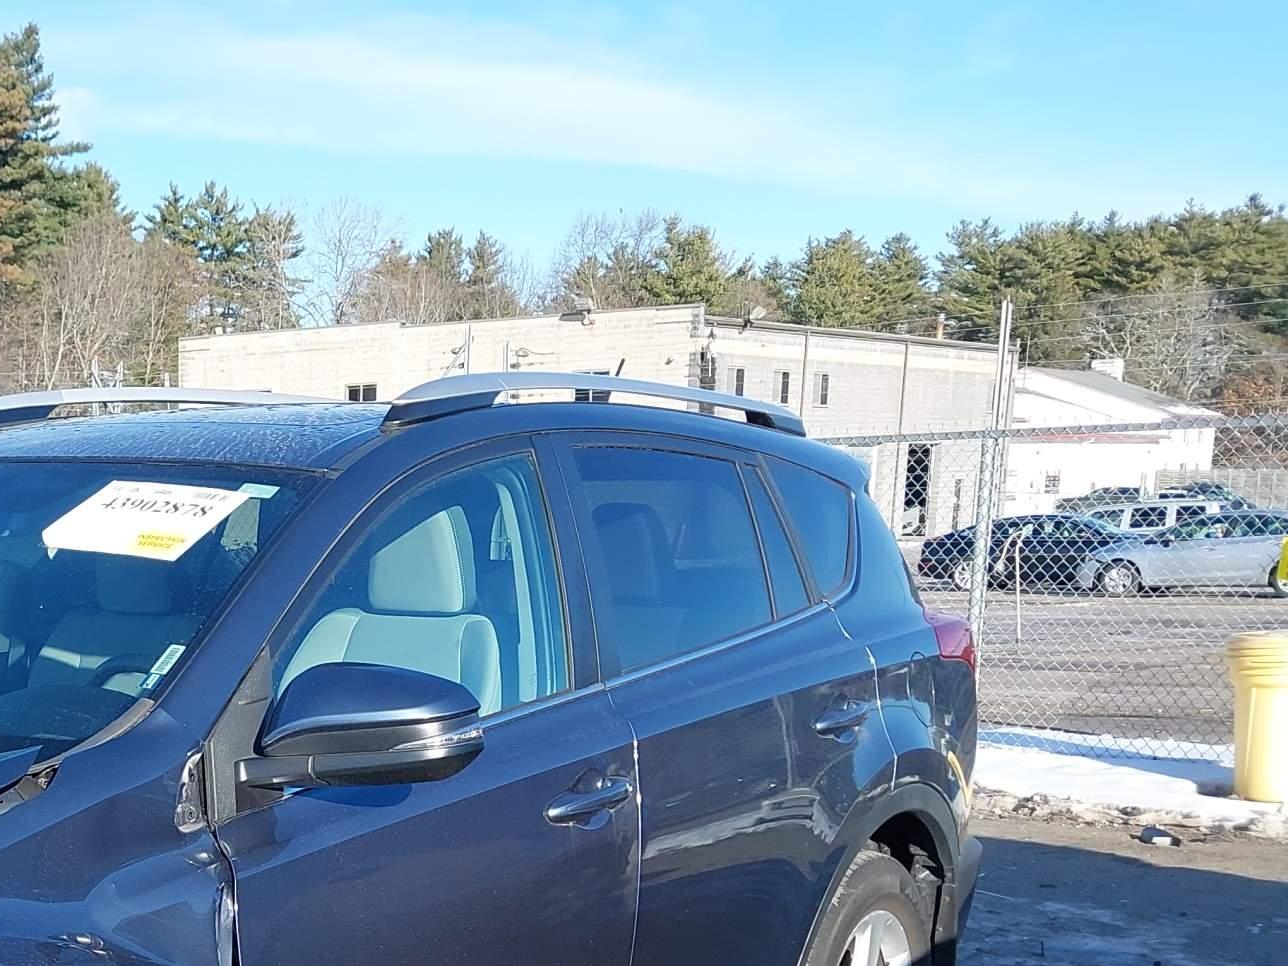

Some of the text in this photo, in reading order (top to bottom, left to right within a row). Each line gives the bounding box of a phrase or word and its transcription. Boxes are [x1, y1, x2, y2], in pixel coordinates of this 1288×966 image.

[101, 497, 213, 517] 43902878
[137, 534, 187, 544] INSPECTION
[137, 540, 173, 549] SERVICE
